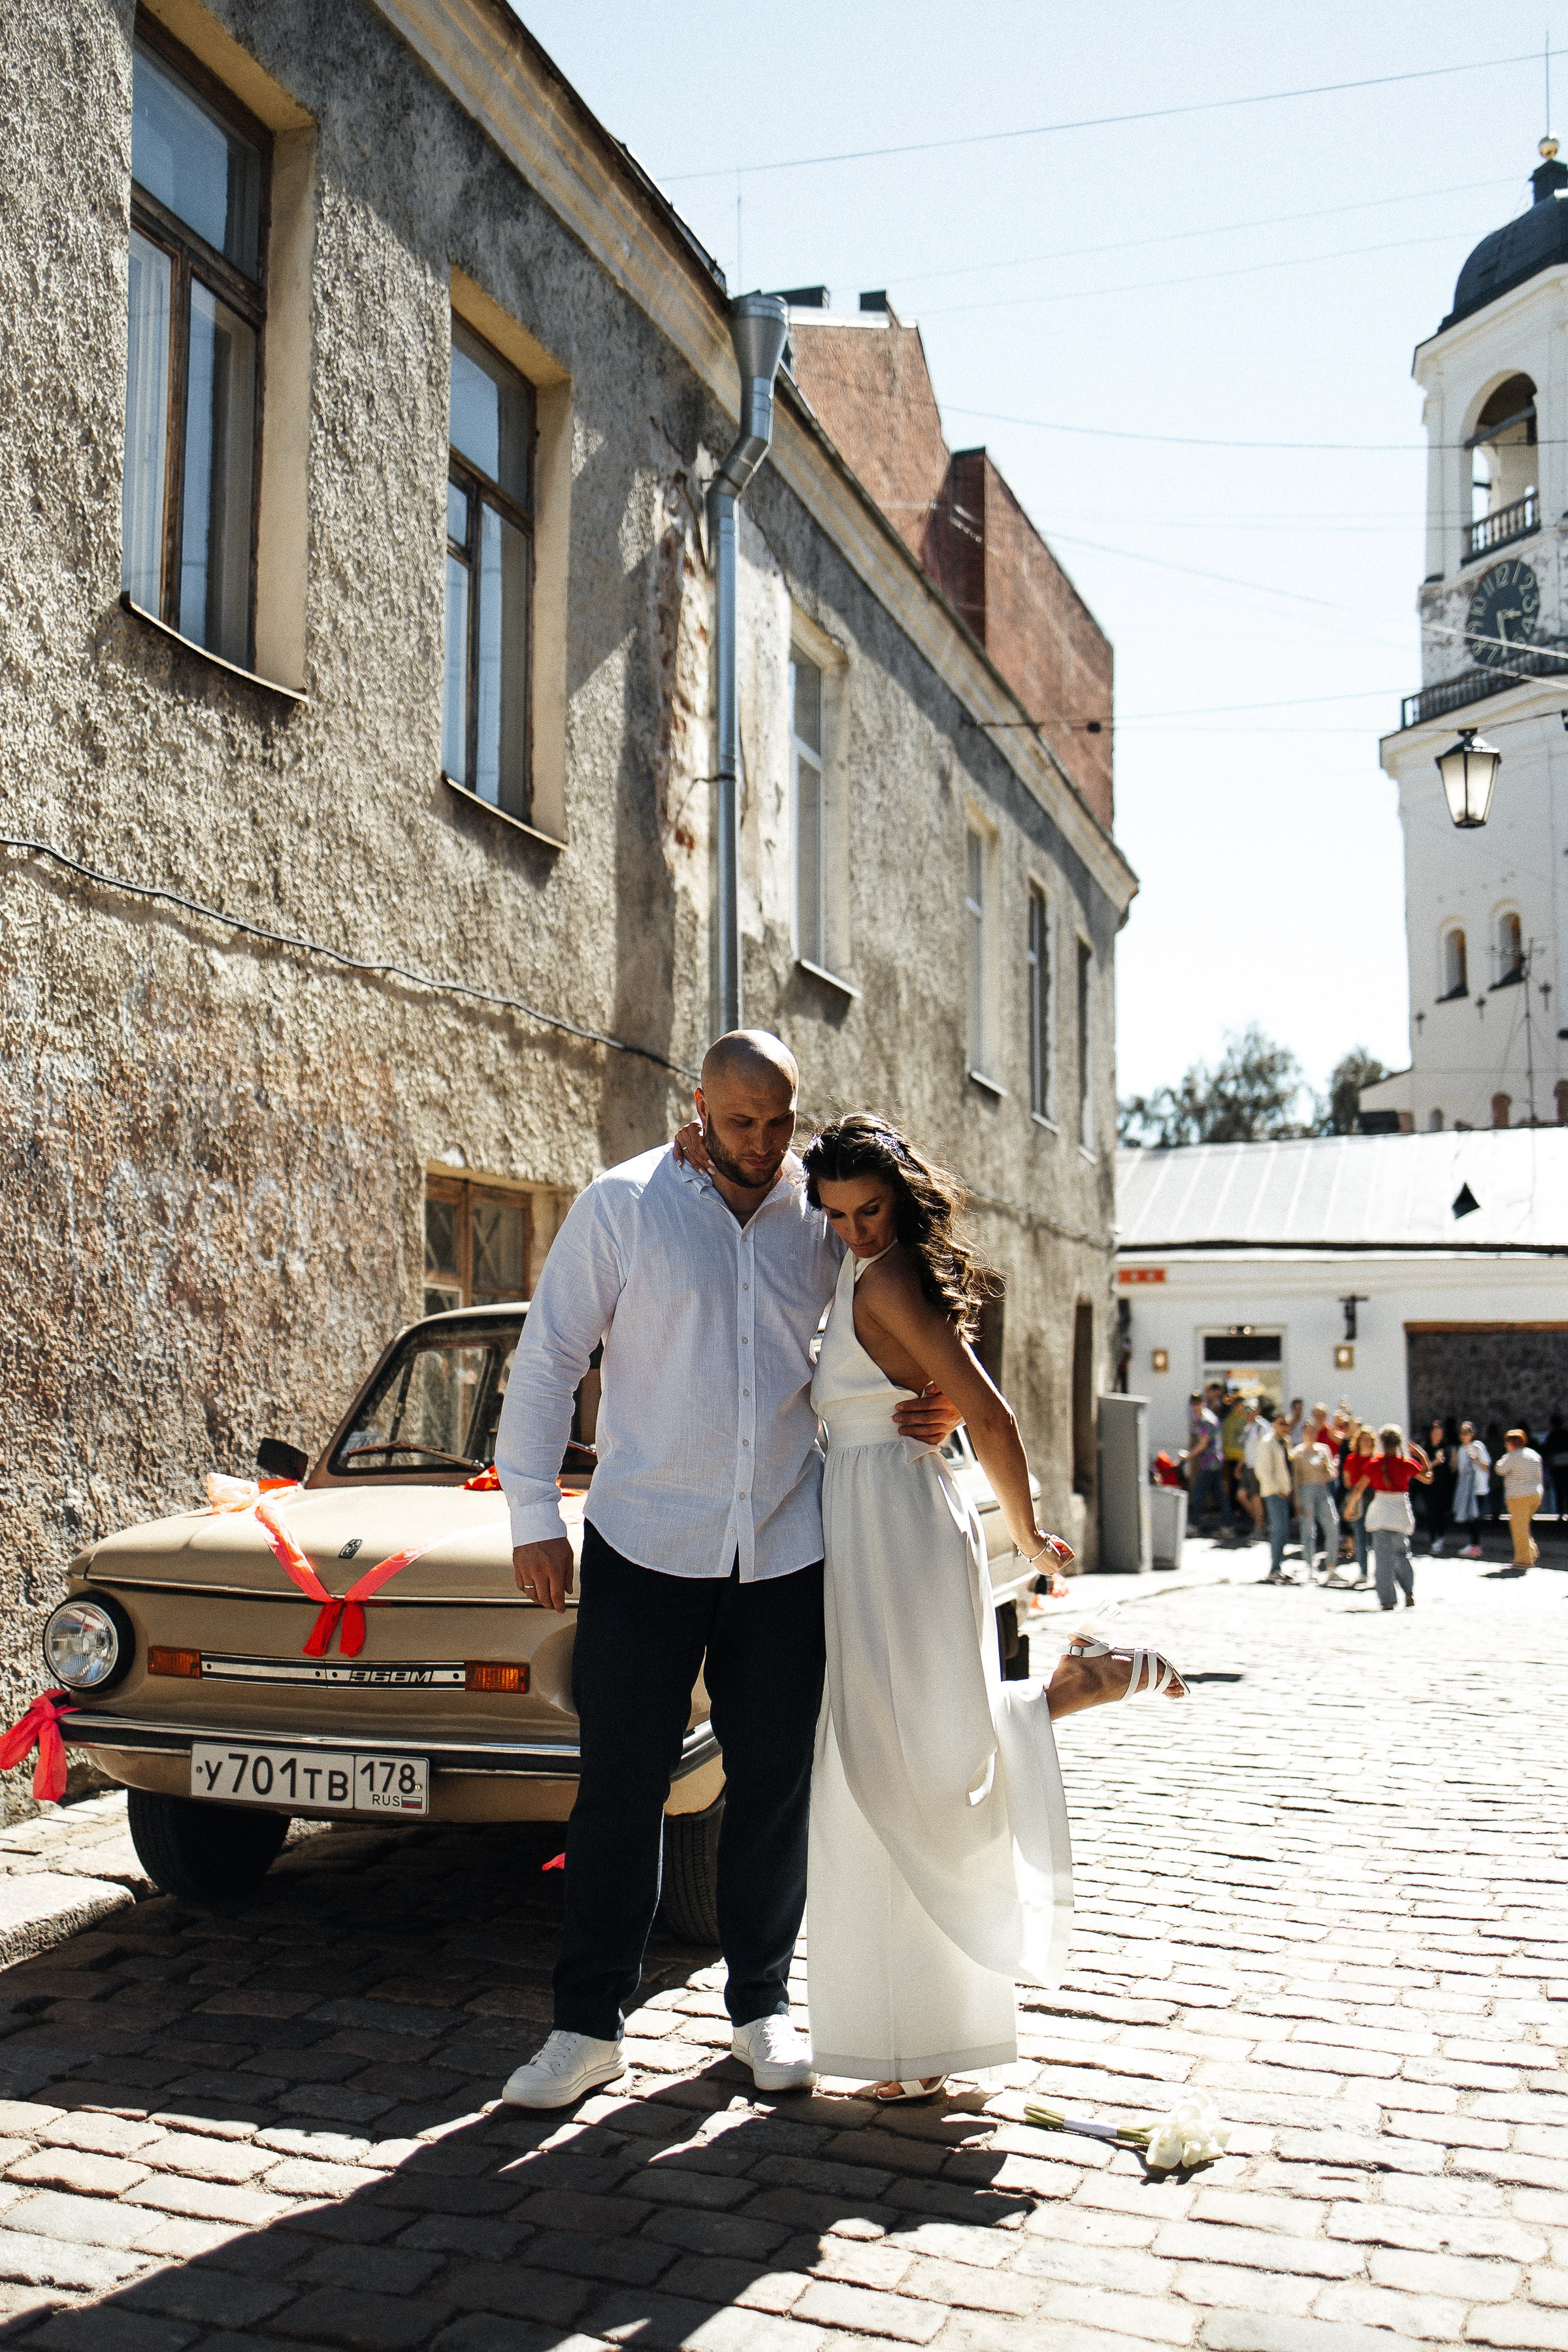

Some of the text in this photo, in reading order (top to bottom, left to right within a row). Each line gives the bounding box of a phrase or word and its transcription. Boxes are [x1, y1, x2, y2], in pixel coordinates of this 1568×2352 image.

[350, 1671, 432, 1682] 968М
[204, 1753, 416, 1801] У701ТВ 178
[372, 1795, 400, 1807] RUS
